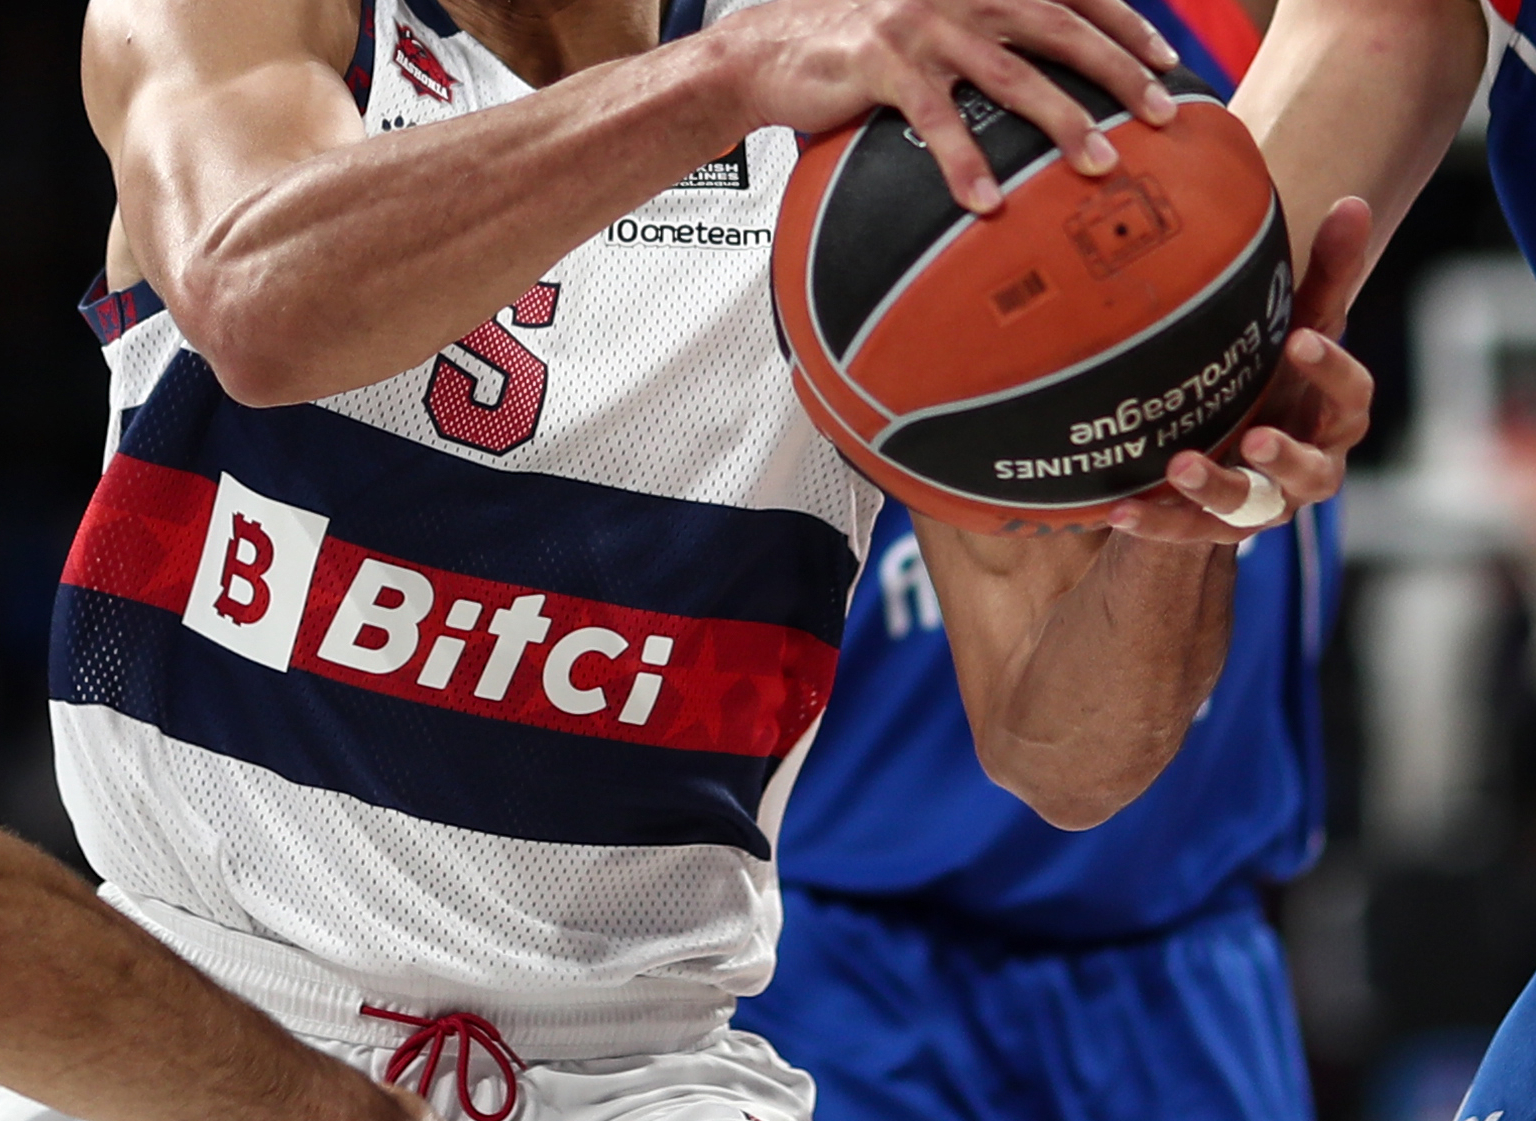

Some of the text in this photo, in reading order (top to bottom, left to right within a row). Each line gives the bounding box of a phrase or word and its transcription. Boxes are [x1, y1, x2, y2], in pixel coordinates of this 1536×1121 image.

[1070, 321, 1262, 446] EuroLeague
[994, 436, 1148, 480] AIRLINES
[316, 558, 673, 726] Bitci
